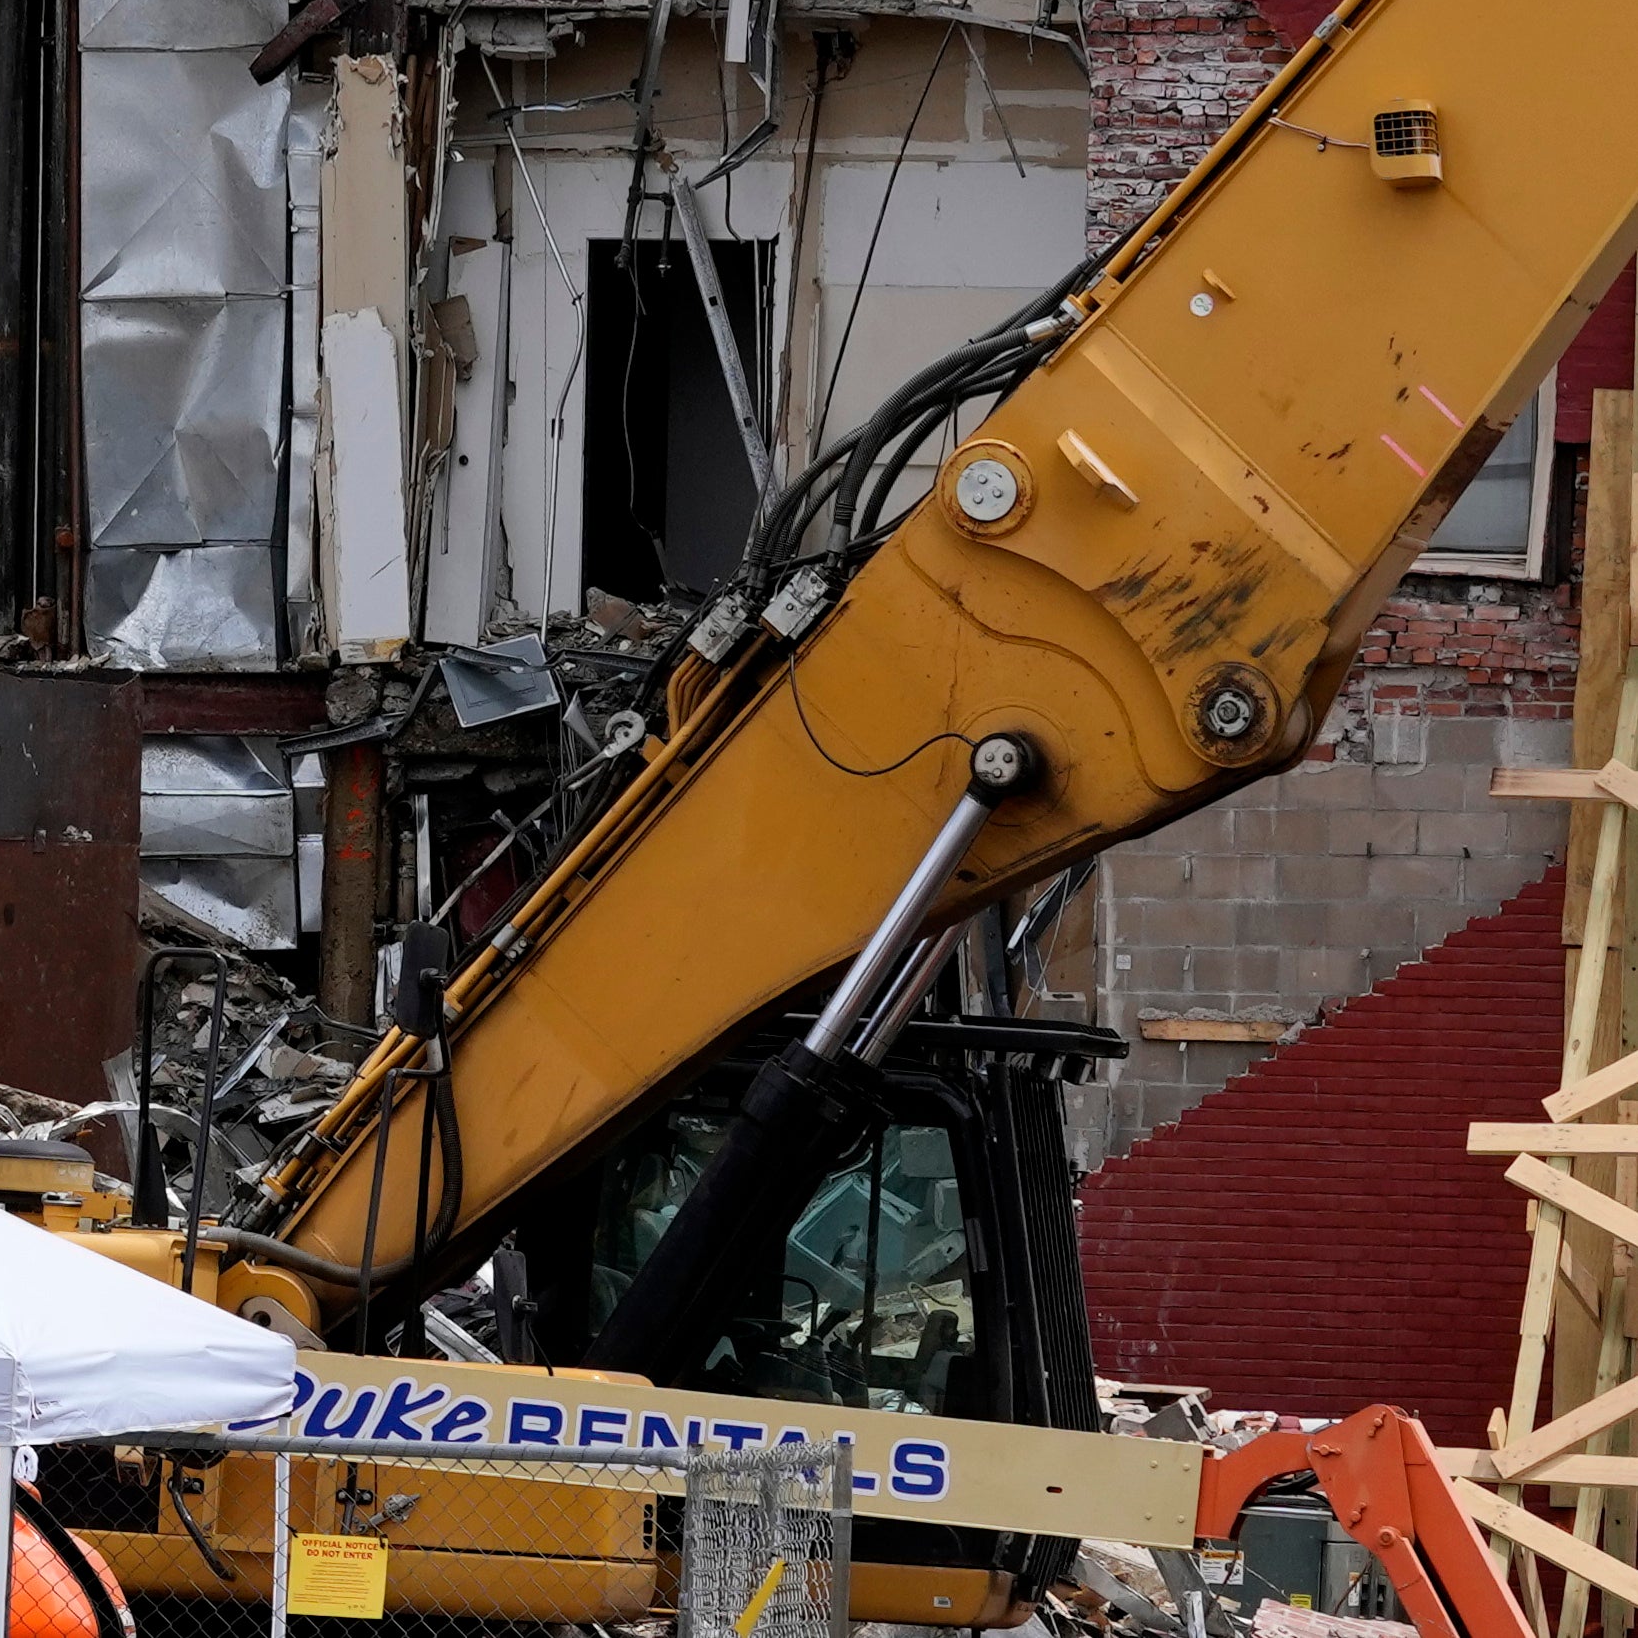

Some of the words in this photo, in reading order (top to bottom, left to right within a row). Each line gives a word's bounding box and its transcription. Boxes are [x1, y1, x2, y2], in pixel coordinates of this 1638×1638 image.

[507, 1401, 946, 1497] RENTS
[301, 1538, 342, 1549] OFFICIAL
[345, 1541, 379, 1551] NOTICE
[306, 1548, 320, 1557] DO
[321, 1549, 341, 1558] NOT
[343, 1551, 374, 1561] ENTER
